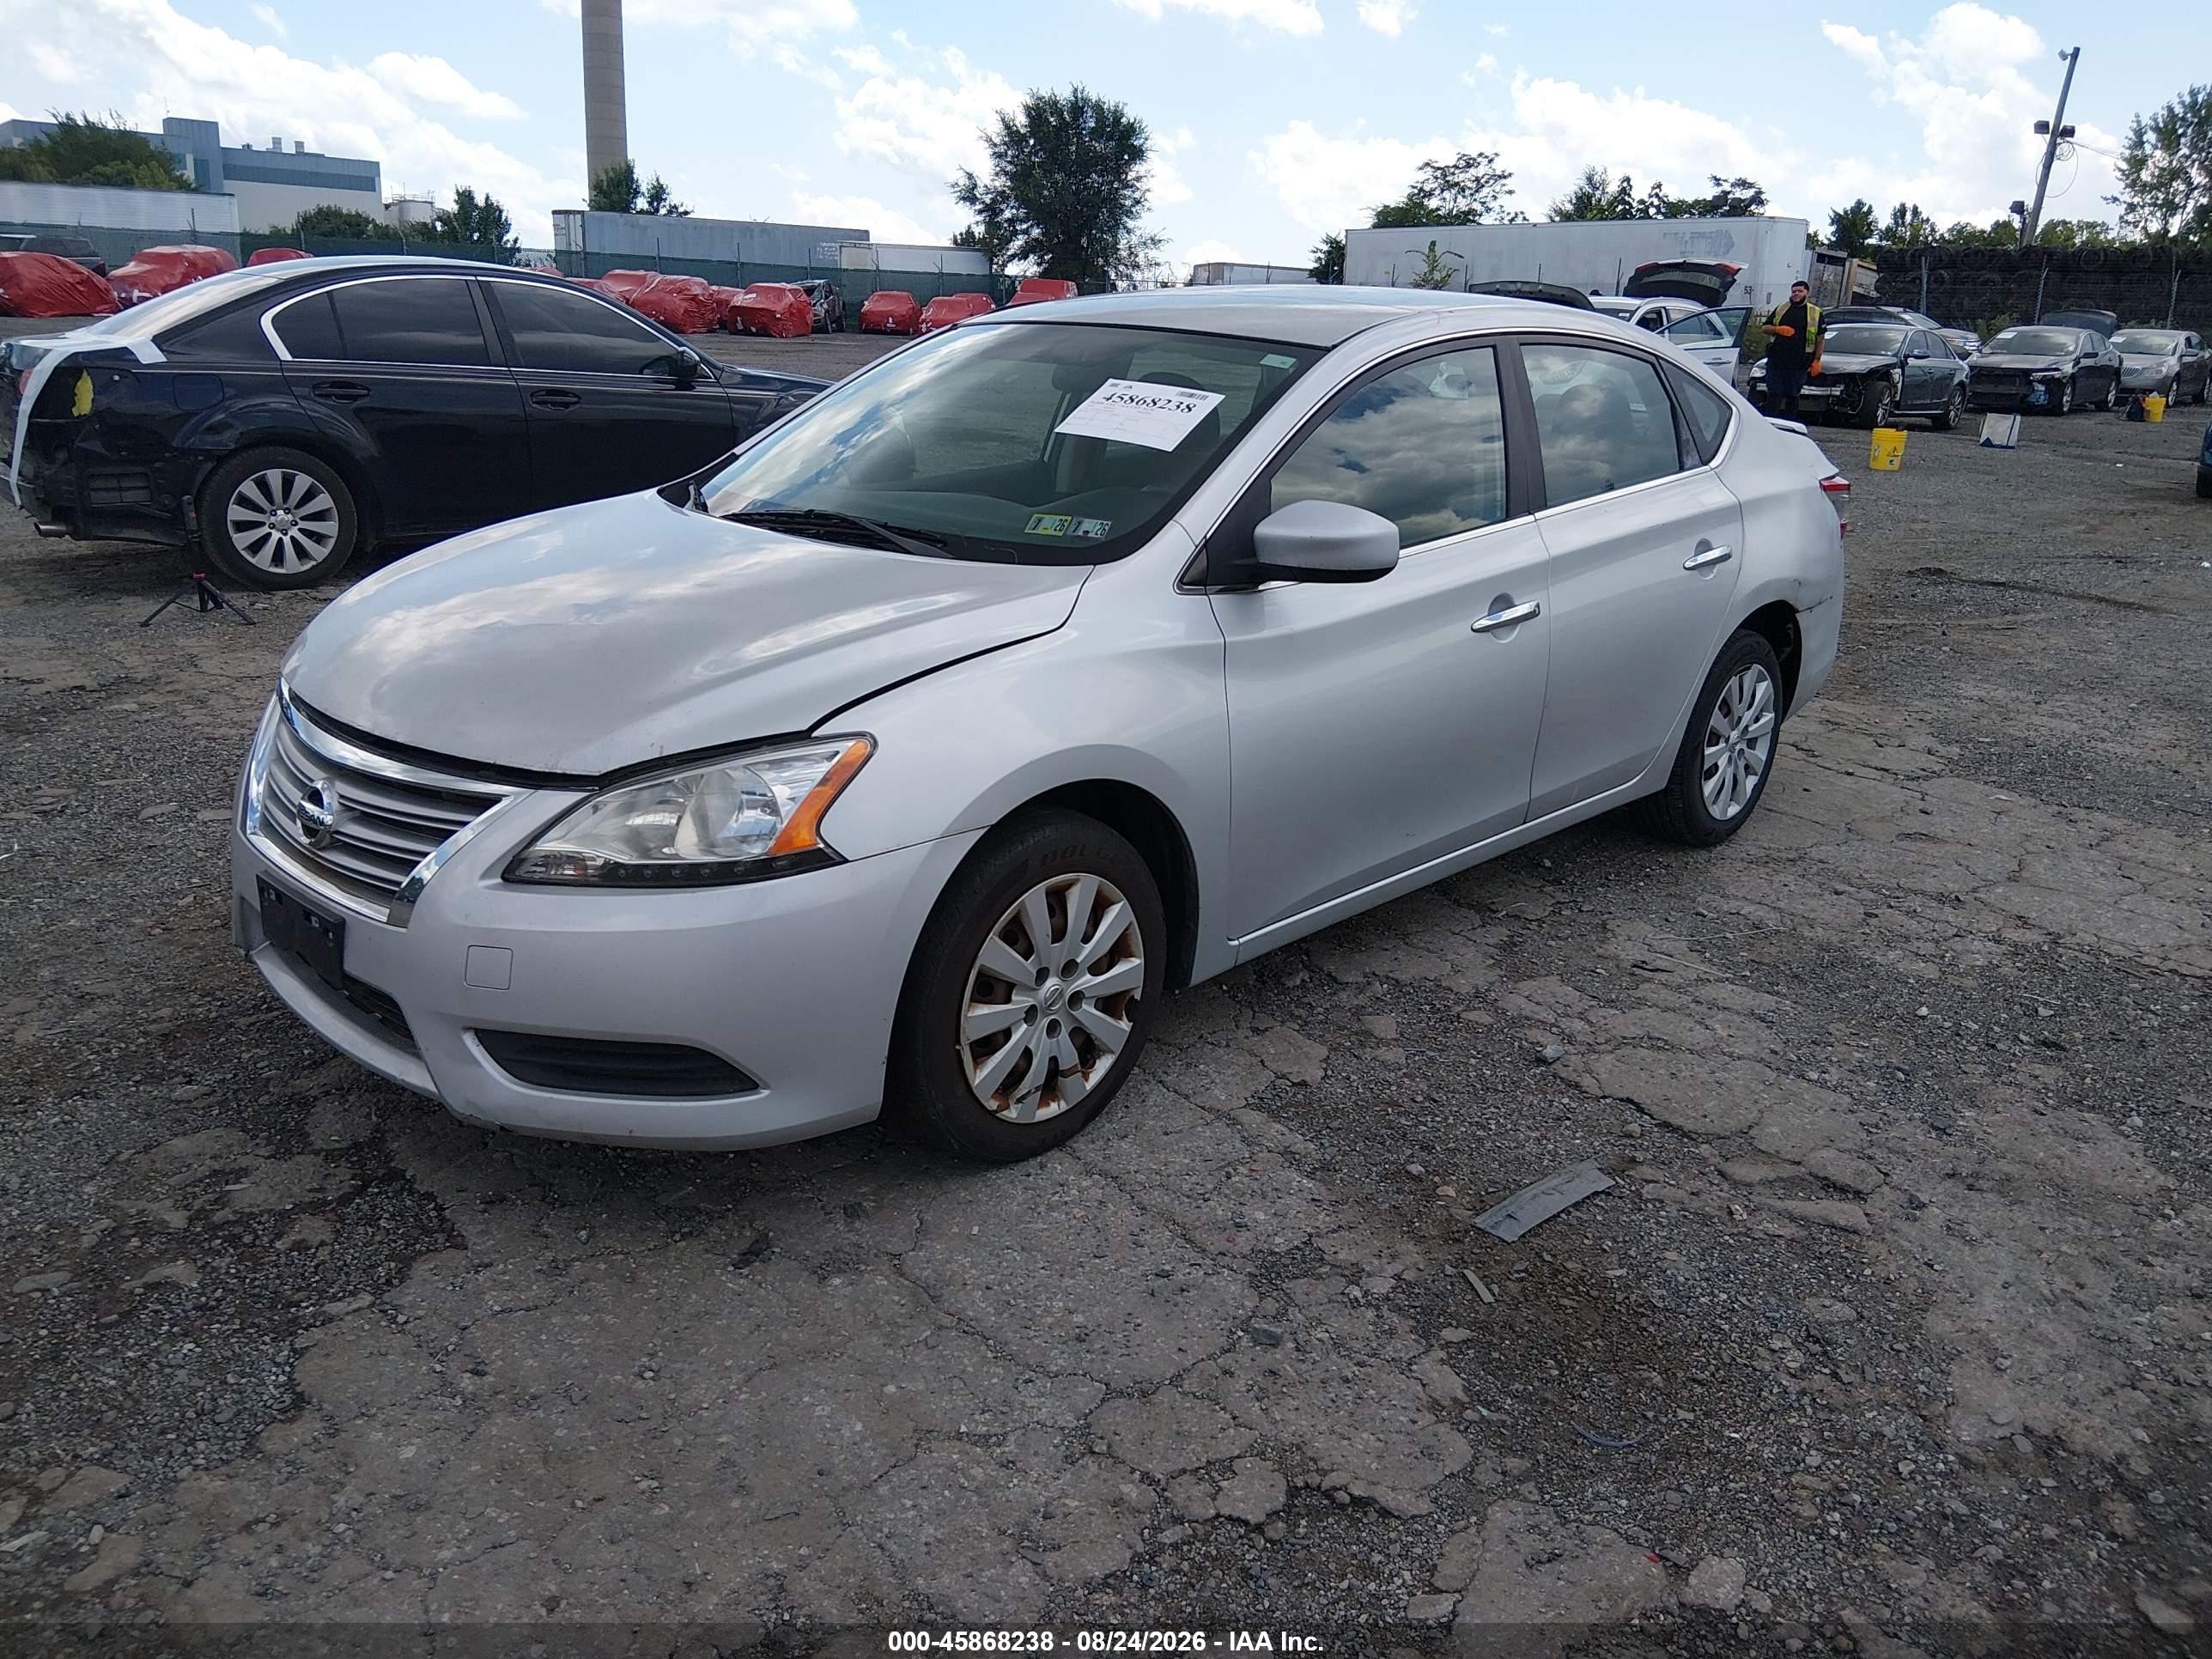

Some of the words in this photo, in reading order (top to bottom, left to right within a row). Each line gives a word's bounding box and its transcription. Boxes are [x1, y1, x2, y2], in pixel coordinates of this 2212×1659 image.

[1102, 392, 1197, 414] 45868238
[1054, 519, 1067, 532] 26
[1095, 522, 1109, 536] 26
